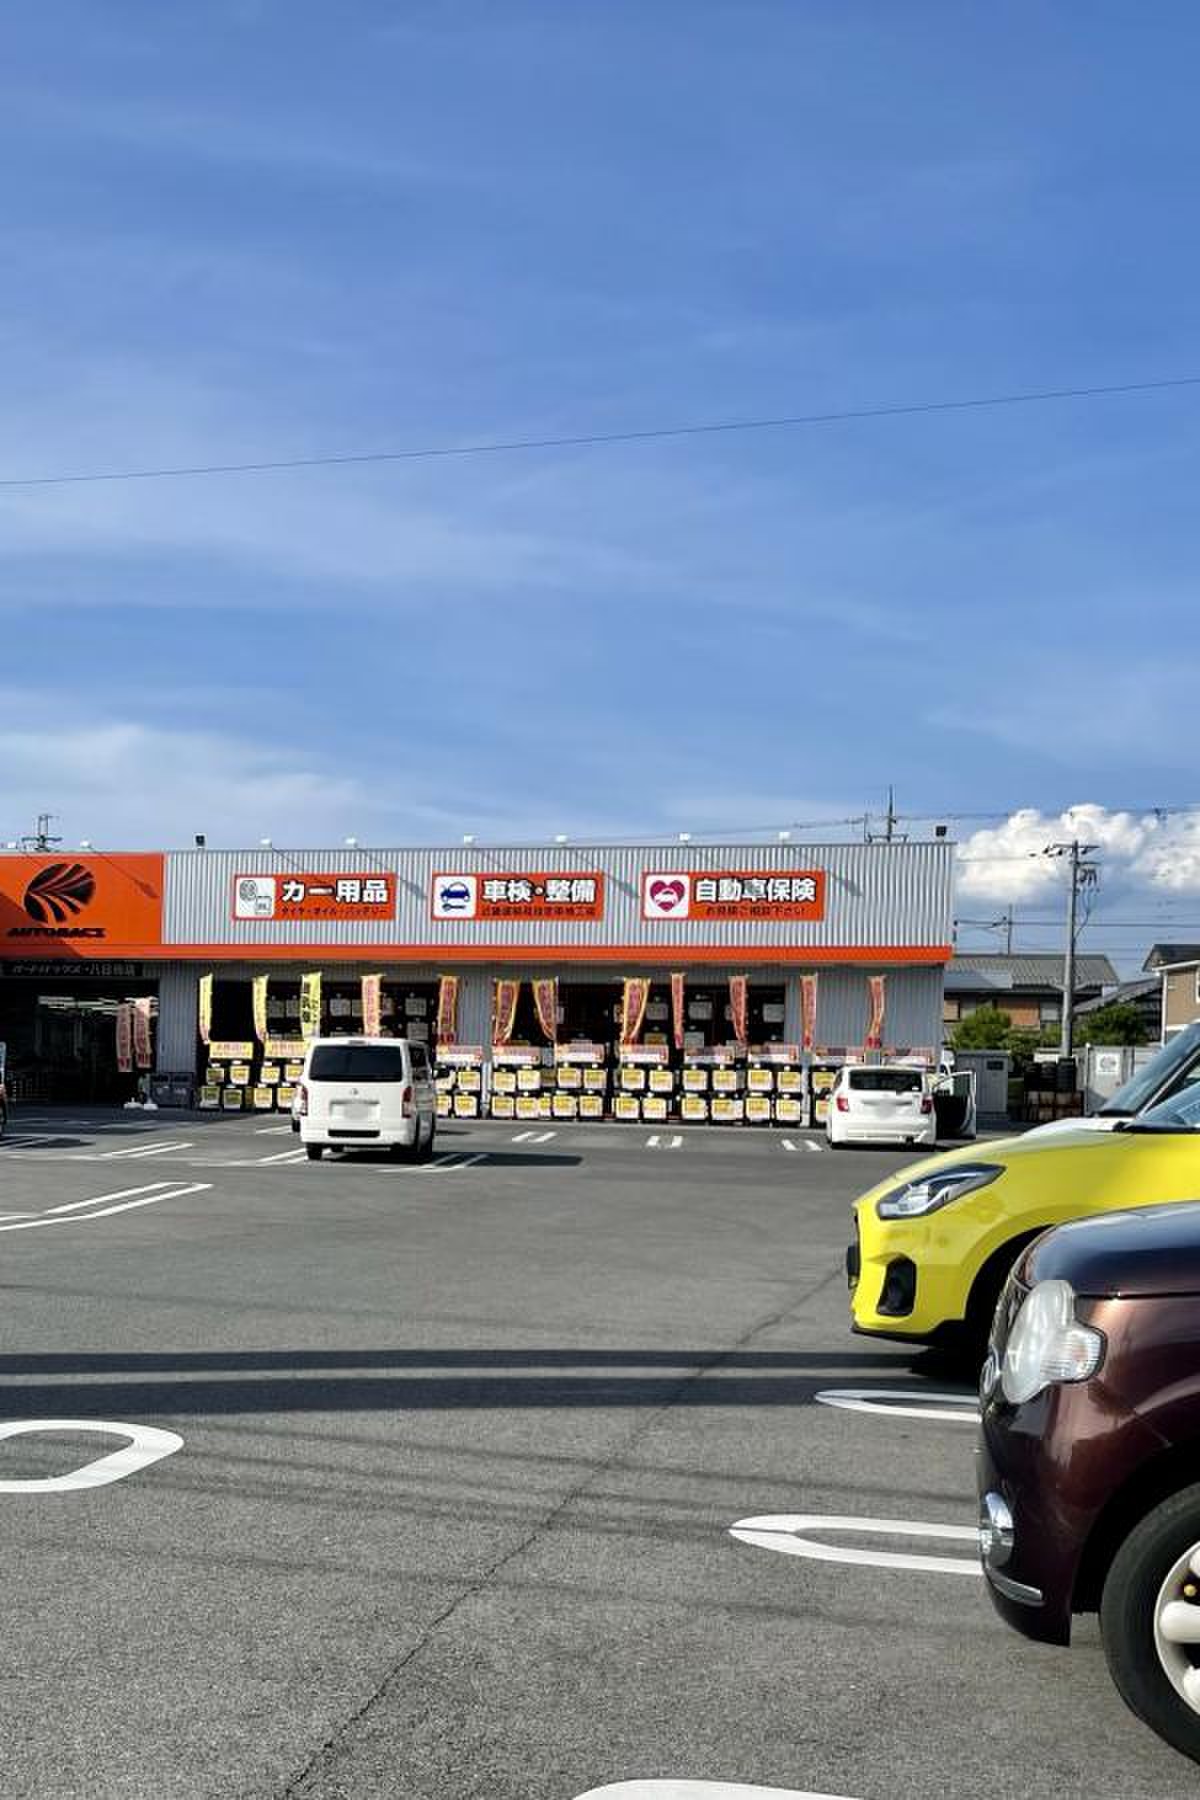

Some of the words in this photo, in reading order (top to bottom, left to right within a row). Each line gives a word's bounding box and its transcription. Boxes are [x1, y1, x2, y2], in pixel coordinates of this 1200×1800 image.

[281, 879, 389, 903] カー用品
[482, 878, 596, 903] 車検・整備
[695, 877, 817, 903] 自動車保険
